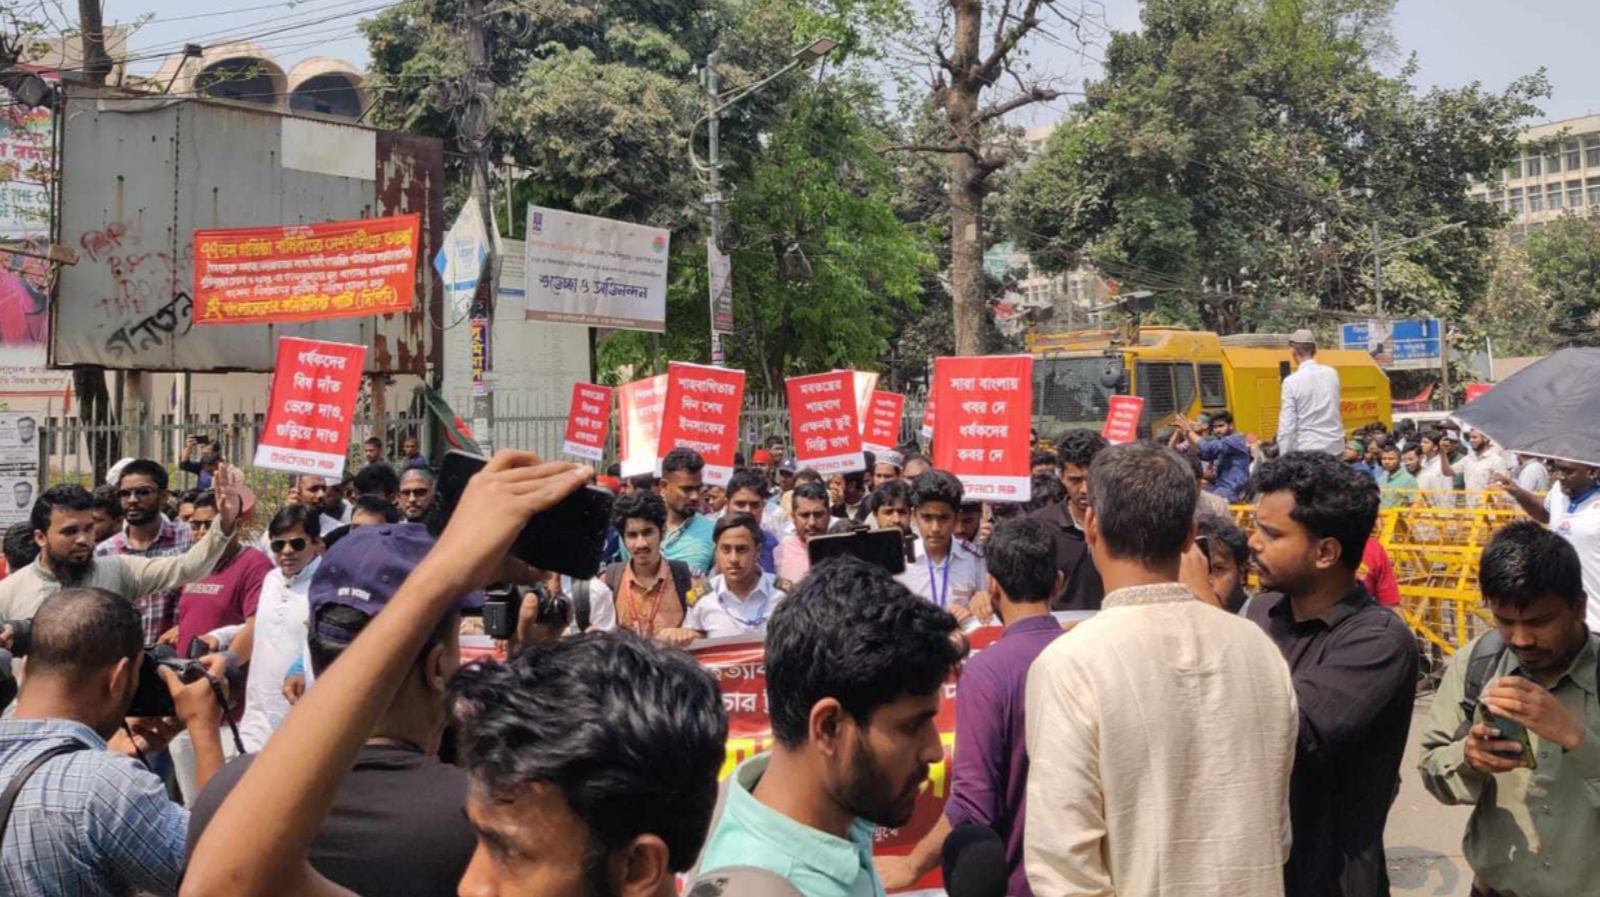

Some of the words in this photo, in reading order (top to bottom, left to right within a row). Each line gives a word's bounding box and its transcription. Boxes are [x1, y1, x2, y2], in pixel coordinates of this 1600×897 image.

[539, 273, 578, 295] শুভেচ্ছা
[580, 279, 590, 293] ও
[593, 276, 649, 299] অভিনন্দন
[298, 348, 348, 370] ধর্ষকদের
[293, 371, 313, 390] বিষ
[317, 375, 343, 393] দাঁত
[950, 377, 975, 391] সারা
[979, 377, 1019, 391] বাংলায়
[681, 395, 699, 410] দিন
[701, 401, 724, 414] শেষ
[805, 398, 841, 413] শাহবাগ
[961, 401, 988, 415] খবর
[991, 401, 1008, 415] দে
[678, 415, 727, 435] ইনসাফের
[959, 421, 1009, 439] ধর্ষকদের
[316, 428, 339, 443] দাও
[957, 448, 985, 462] কবর
[988, 449, 1005, 462] দে
